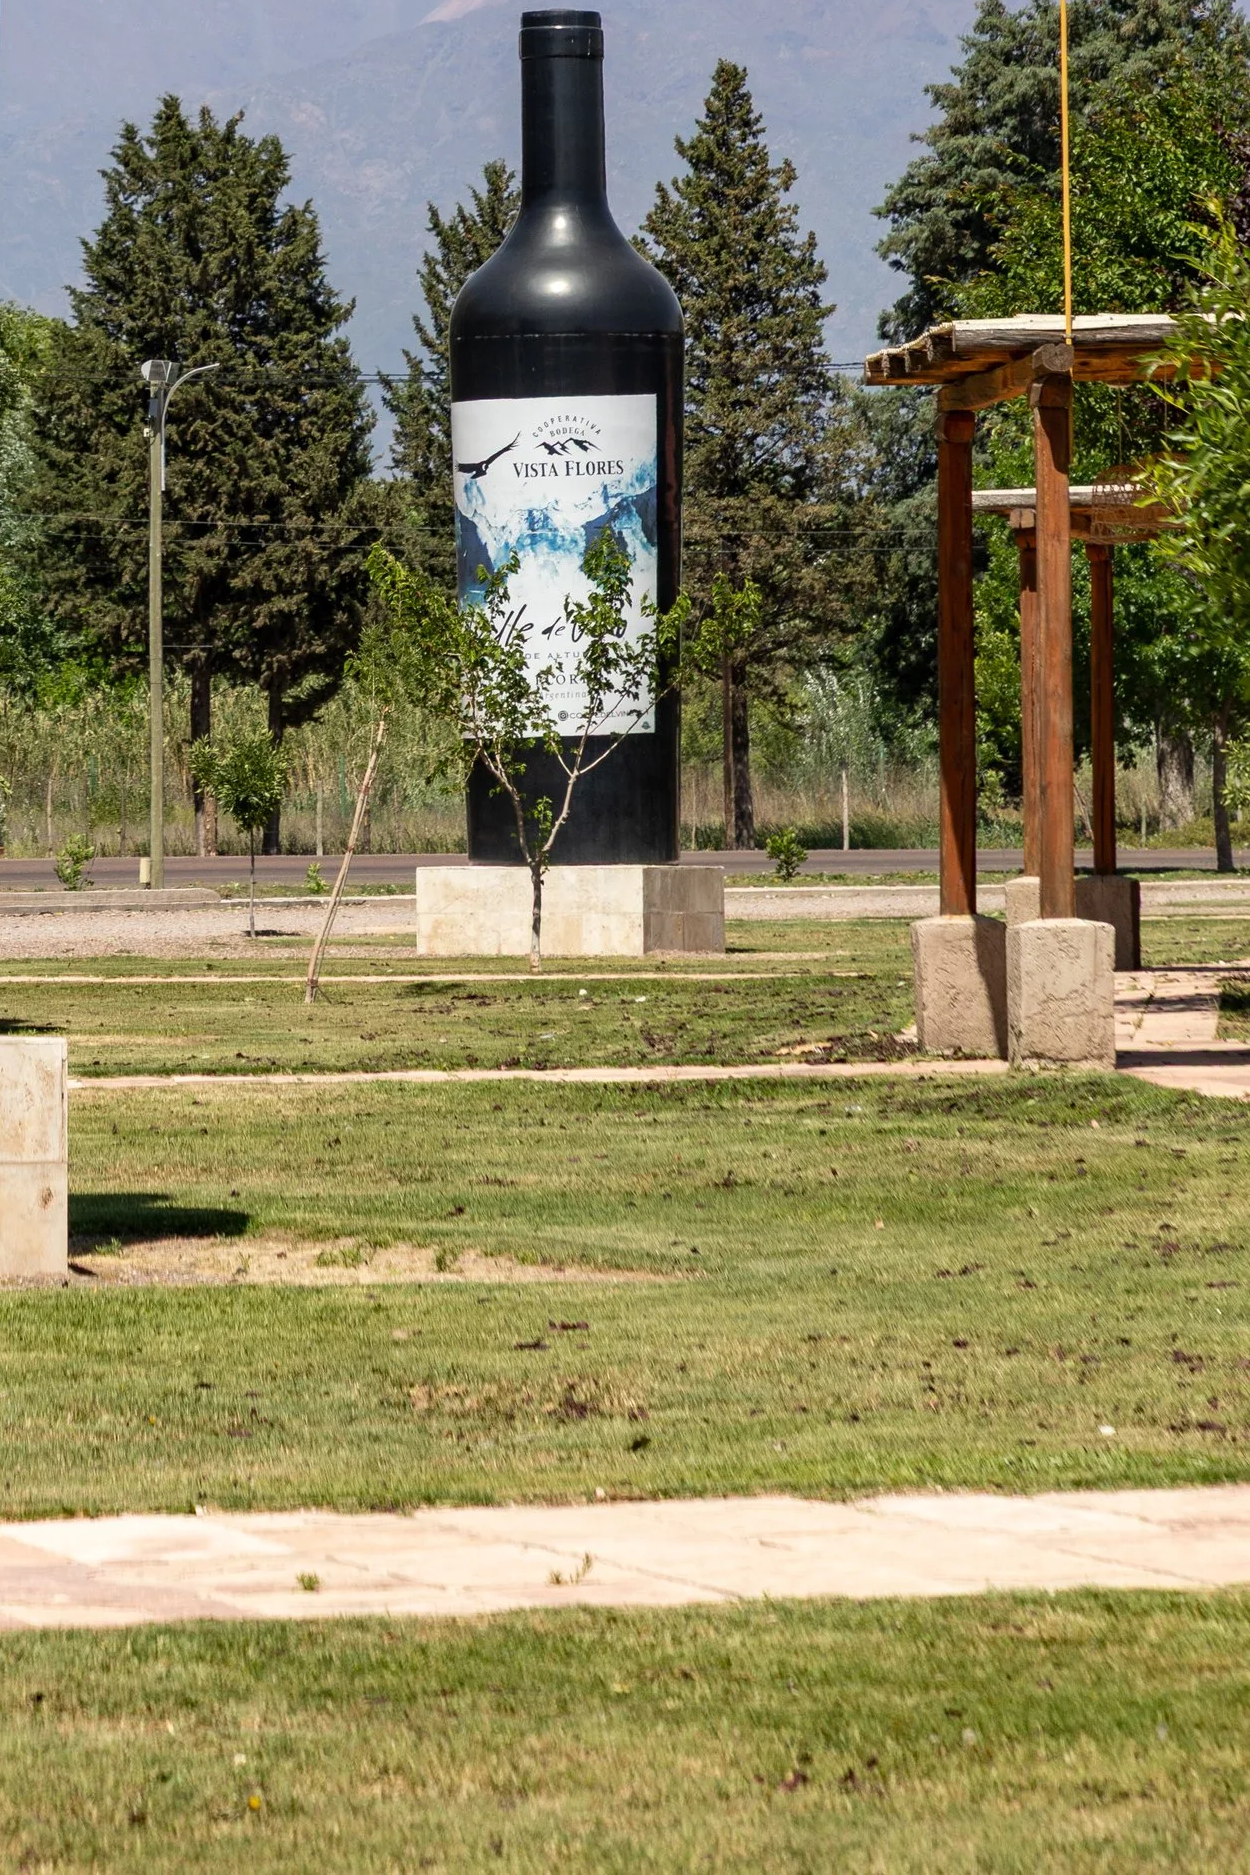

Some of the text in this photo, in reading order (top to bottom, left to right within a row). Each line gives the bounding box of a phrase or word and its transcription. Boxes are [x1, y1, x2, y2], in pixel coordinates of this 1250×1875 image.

[532, 414, 601, 438] COOPERATIVA
[549, 427, 585, 437] BODEGA
[513, 460, 624, 478] VISTA FLORES
[541, 616, 565, 640] de
